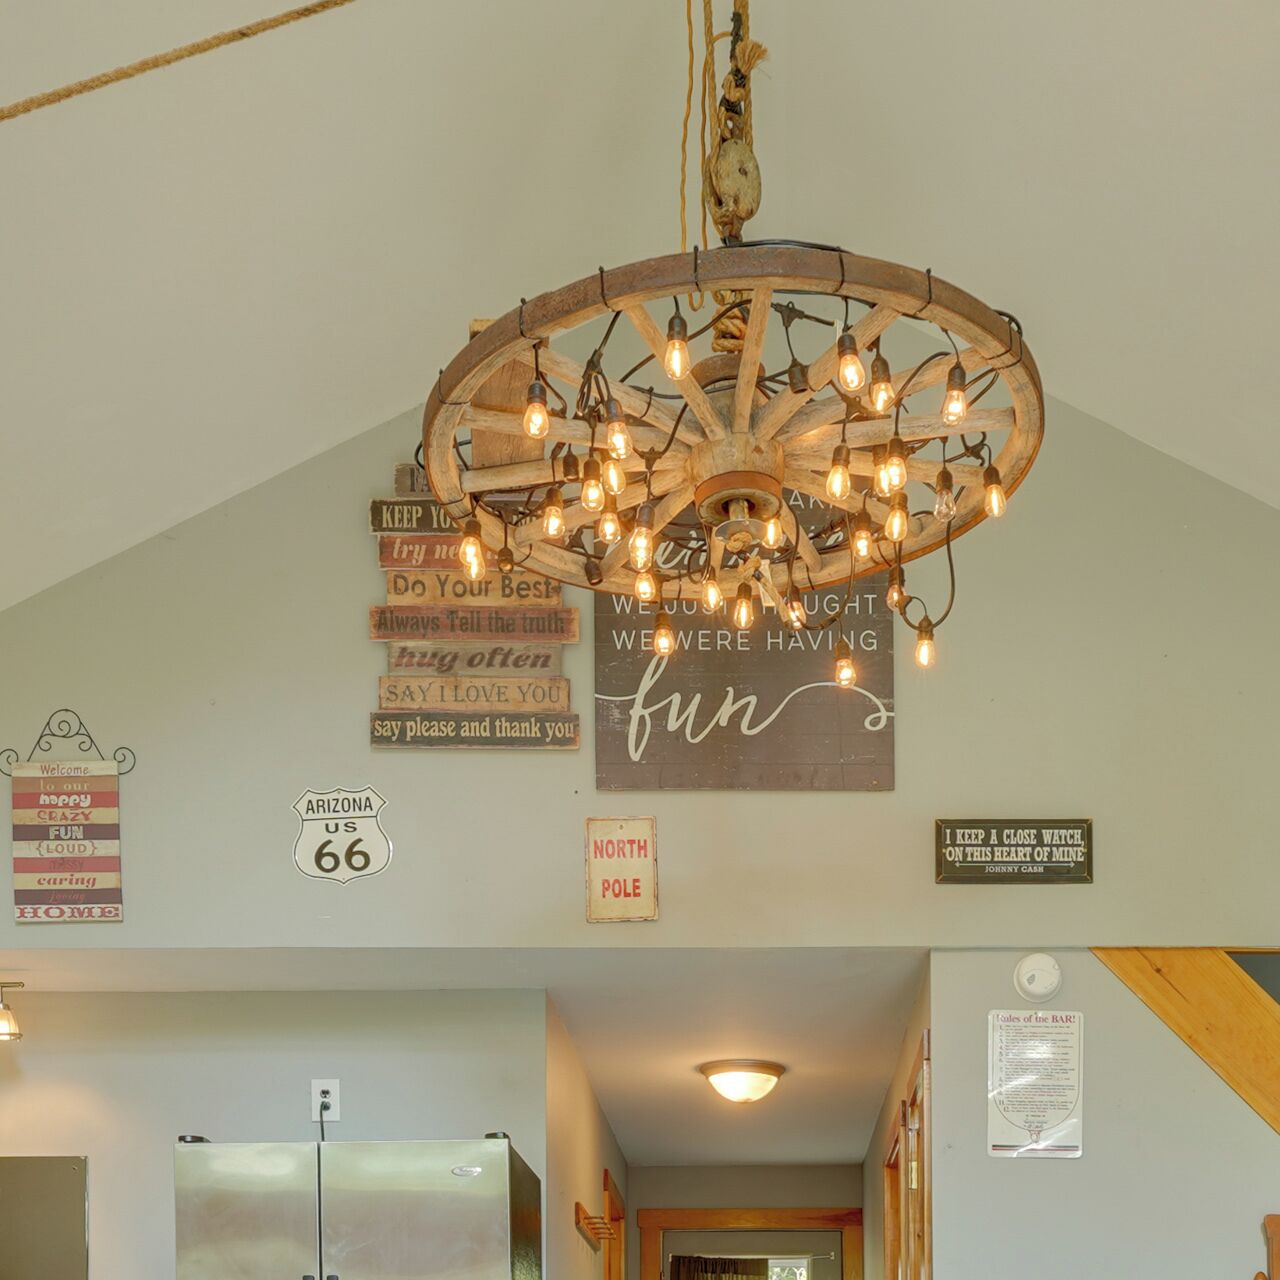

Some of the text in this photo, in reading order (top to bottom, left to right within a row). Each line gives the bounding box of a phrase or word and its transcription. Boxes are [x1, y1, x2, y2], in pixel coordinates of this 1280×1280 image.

[382, 505, 458, 529] KEEP YO
[392, 538, 428, 566] try
[435, 543, 460, 560] ne
[393, 575, 554, 599] Do Your Best
[377, 609, 566, 637] Always Tell the truth
[612, 629, 654, 651] WE
[674, 629, 751, 651] WERE
[394, 646, 553, 673] hug often
[385, 682, 561, 703] SAY I LOVE YOU
[374, 716, 575, 742] say please and thank you
[40, 763, 89, 776] Welcome
[63, 782, 90, 791] our
[39, 793, 91, 808] happy
[305, 796, 374, 815] ARIZONA
[36, 808, 94, 824] CRAZY
[48, 825, 85, 840] FUN
[324, 820, 358, 834] US
[945, 828, 1085, 847] I KEEP A CLOSE WATCH,
[314, 837, 372, 874] 66
[593, 839, 648, 859] NORTH
[945, 846, 1085, 862] ON THIS HEART OF MINE
[36, 873, 97, 888] caring
[601, 878, 642, 899] POLE
[16, 906, 120, 919] HOME
[1023, 1014, 1033, 1024] of
[1035, 1014, 1049, 1024] the
[1051, 1014, 1076, 1024] BAR!
